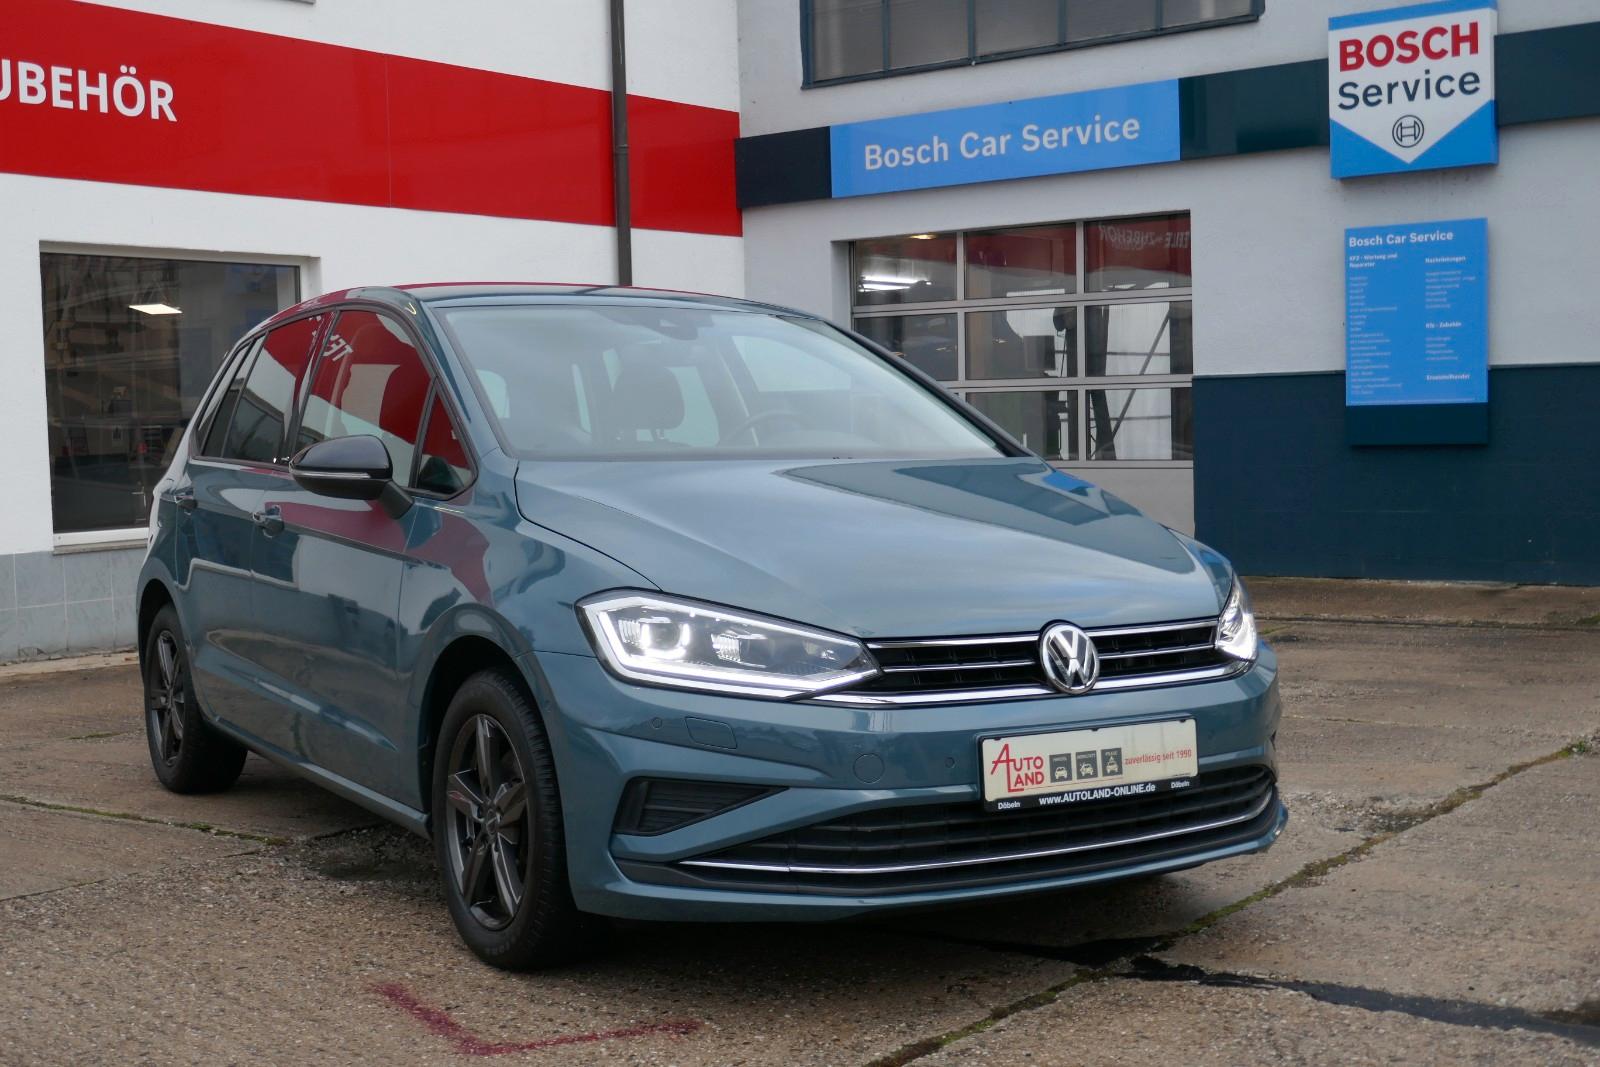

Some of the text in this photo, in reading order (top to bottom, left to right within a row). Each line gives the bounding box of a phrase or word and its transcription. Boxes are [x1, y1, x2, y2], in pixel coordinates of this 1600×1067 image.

[1339, 21, 1479, 72] BOSCH
[1338, 68, 1480, 111] Service
[864, 115, 1141, 170] Bosch Car Service
[1349, 230, 1454, 248] Bosch Car Service
[991, 744, 1044, 775] AUTO
[1125, 754, 1161, 766] zuverlässig
[1162, 753, 1175, 761] seit
[1177, 748, 1192, 758] 1990
[1007, 771, 1045, 793] LAND
[1170, 780, 1190, 789] Döbeln
[1039, 783, 1156, 805] www.AUTOLAND-ONLINE.de
[997, 801, 1021, 810] Döbeln
